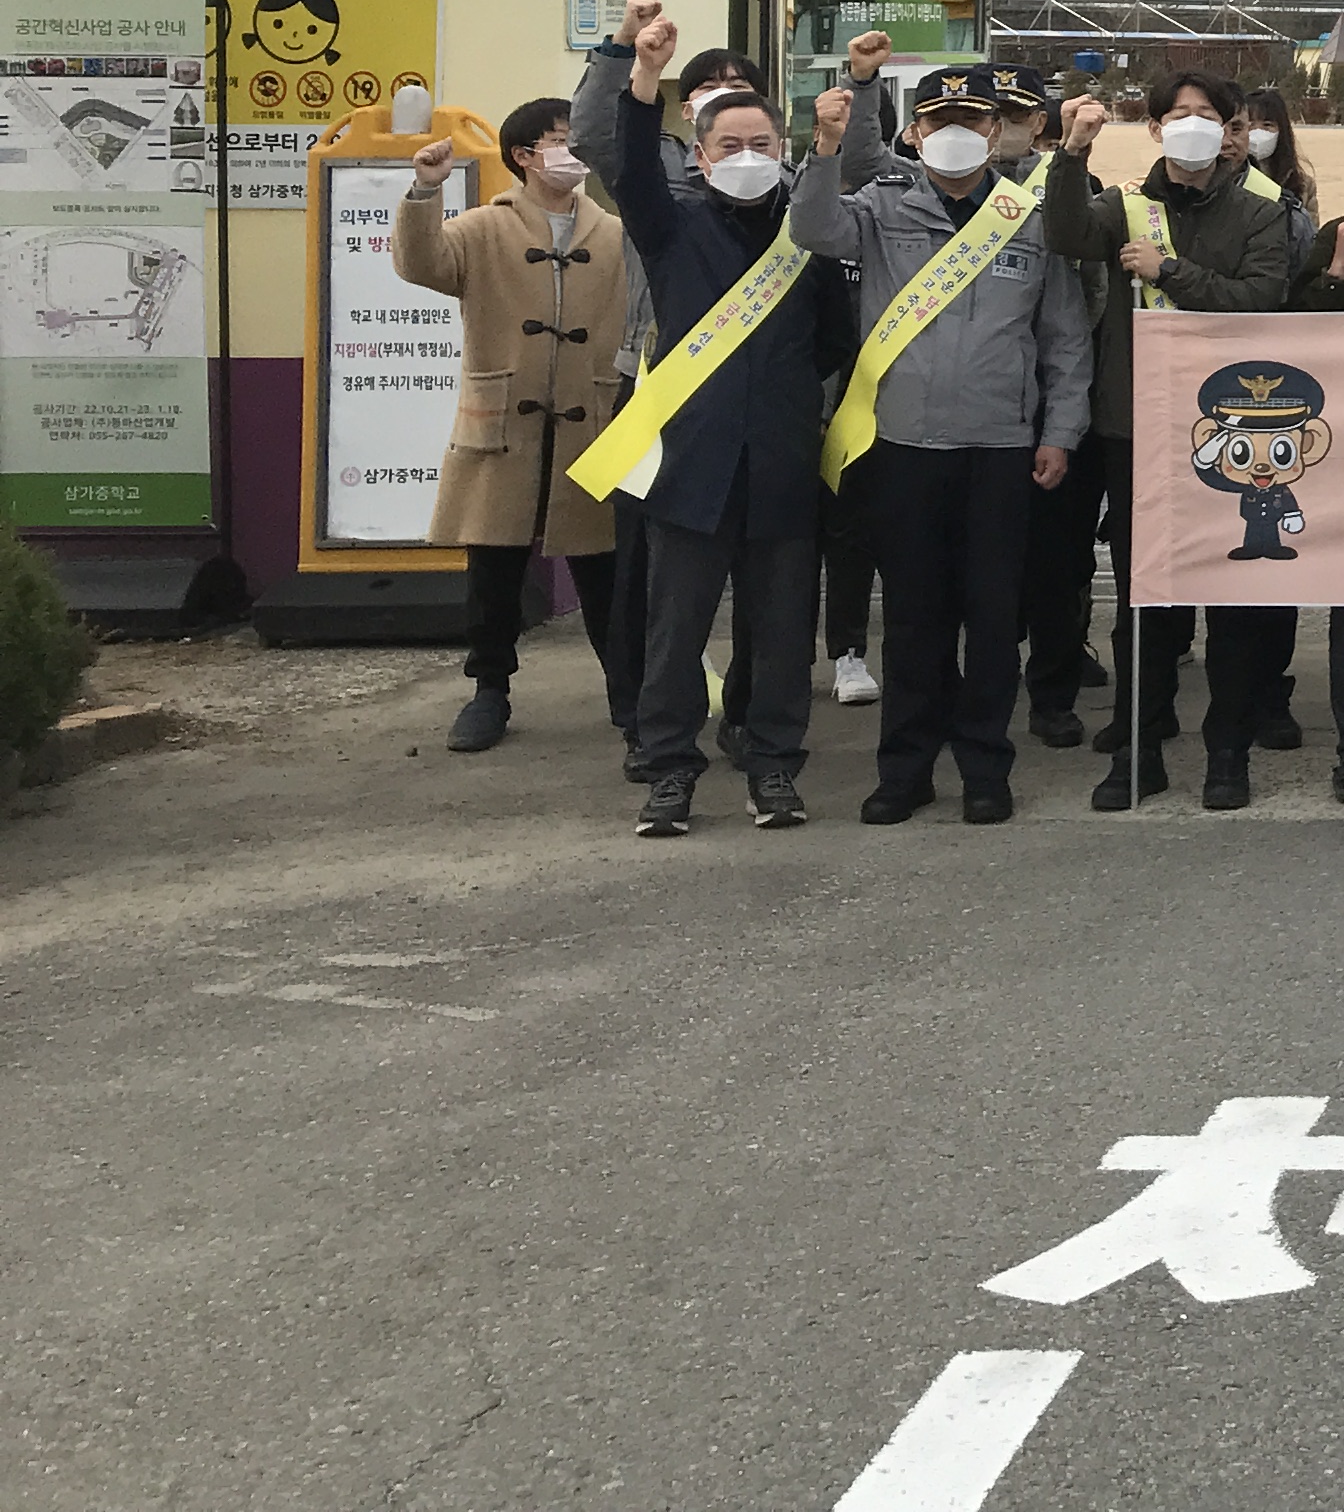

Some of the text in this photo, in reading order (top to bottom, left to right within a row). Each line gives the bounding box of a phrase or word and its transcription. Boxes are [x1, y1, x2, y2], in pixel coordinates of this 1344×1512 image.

[15, 19, 186, 36] 공간혁신사업 공사 안내
[248, 184, 307, 199] 삼가중학
[339, 209, 389, 225] 외부인
[346, 236, 362, 253] 및
[350, 308, 451, 324] 학교 내 외부출입인은
[343, 376, 375, 391] 경유해
[379, 376, 410, 391] 주시기
[364, 467, 439, 483] 삼가중학교
[64, 485, 140, 501] 삼가중학교
